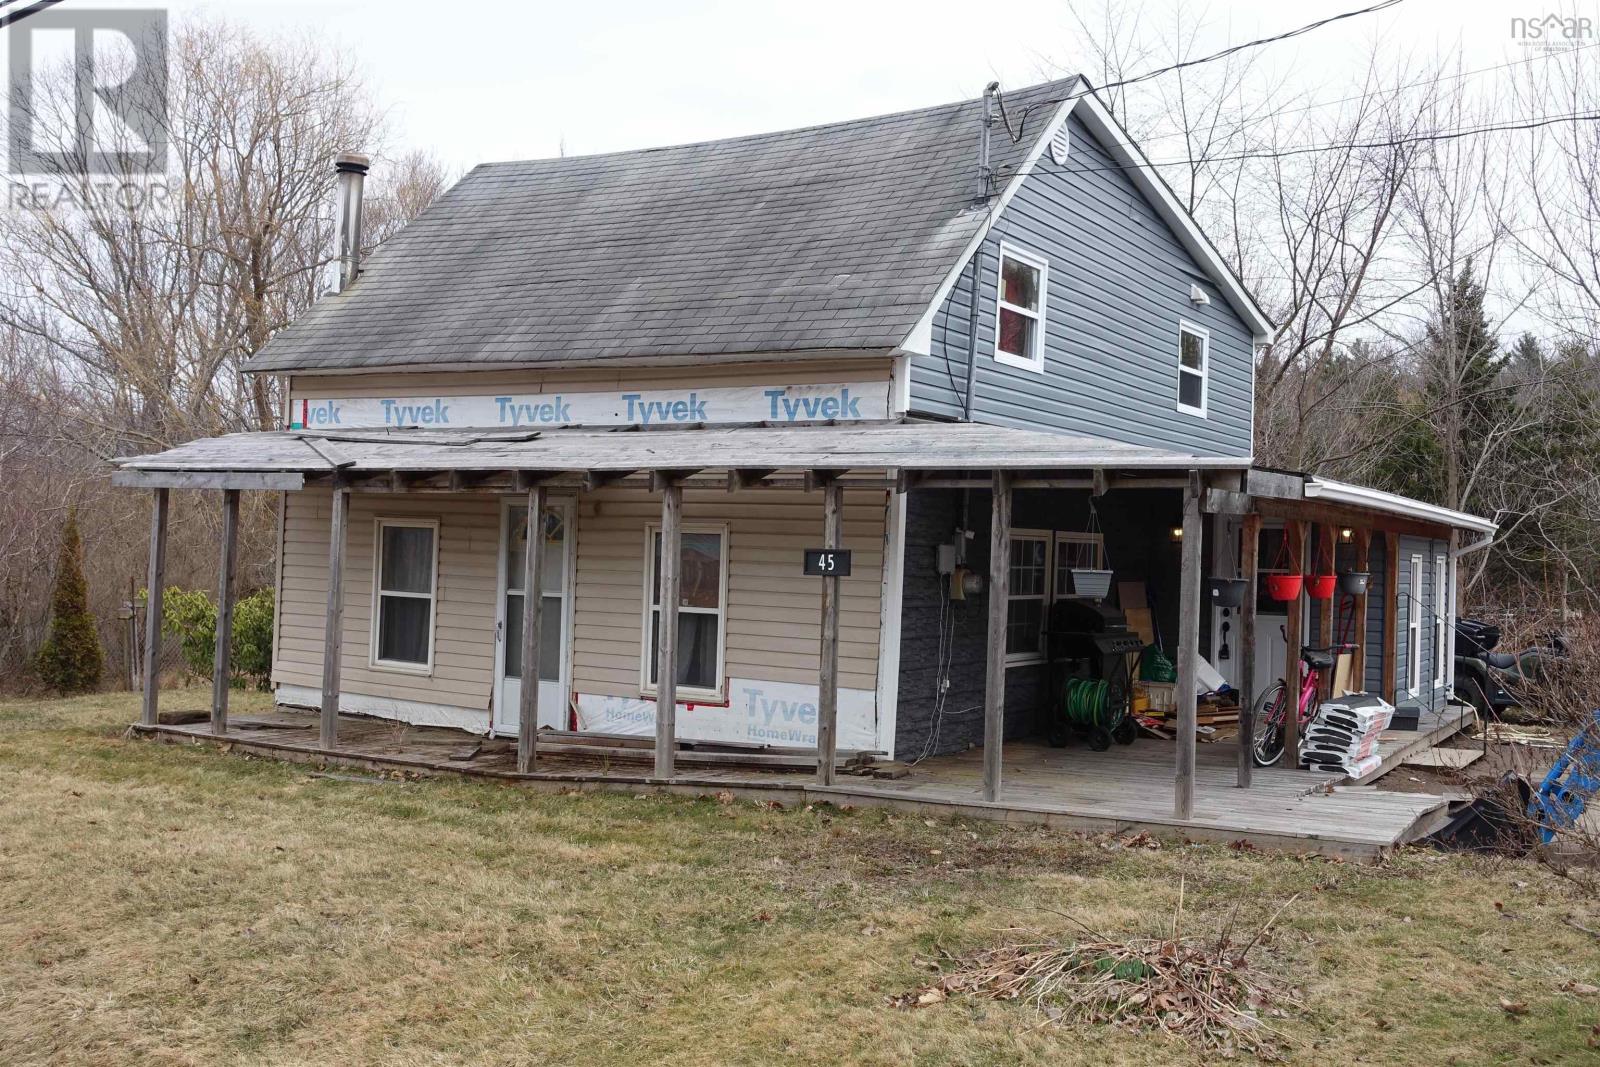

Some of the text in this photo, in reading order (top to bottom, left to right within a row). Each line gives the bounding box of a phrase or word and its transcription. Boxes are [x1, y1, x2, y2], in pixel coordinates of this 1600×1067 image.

[308, 388, 862, 427] vek Tyvek Tyvek Tyvek Tyvek
[818, 553, 835, 571] 45
[606, 708, 656, 722] HomeW
[742, 687, 818, 726] Tyve
[747, 724, 817, 744] HomeWra
